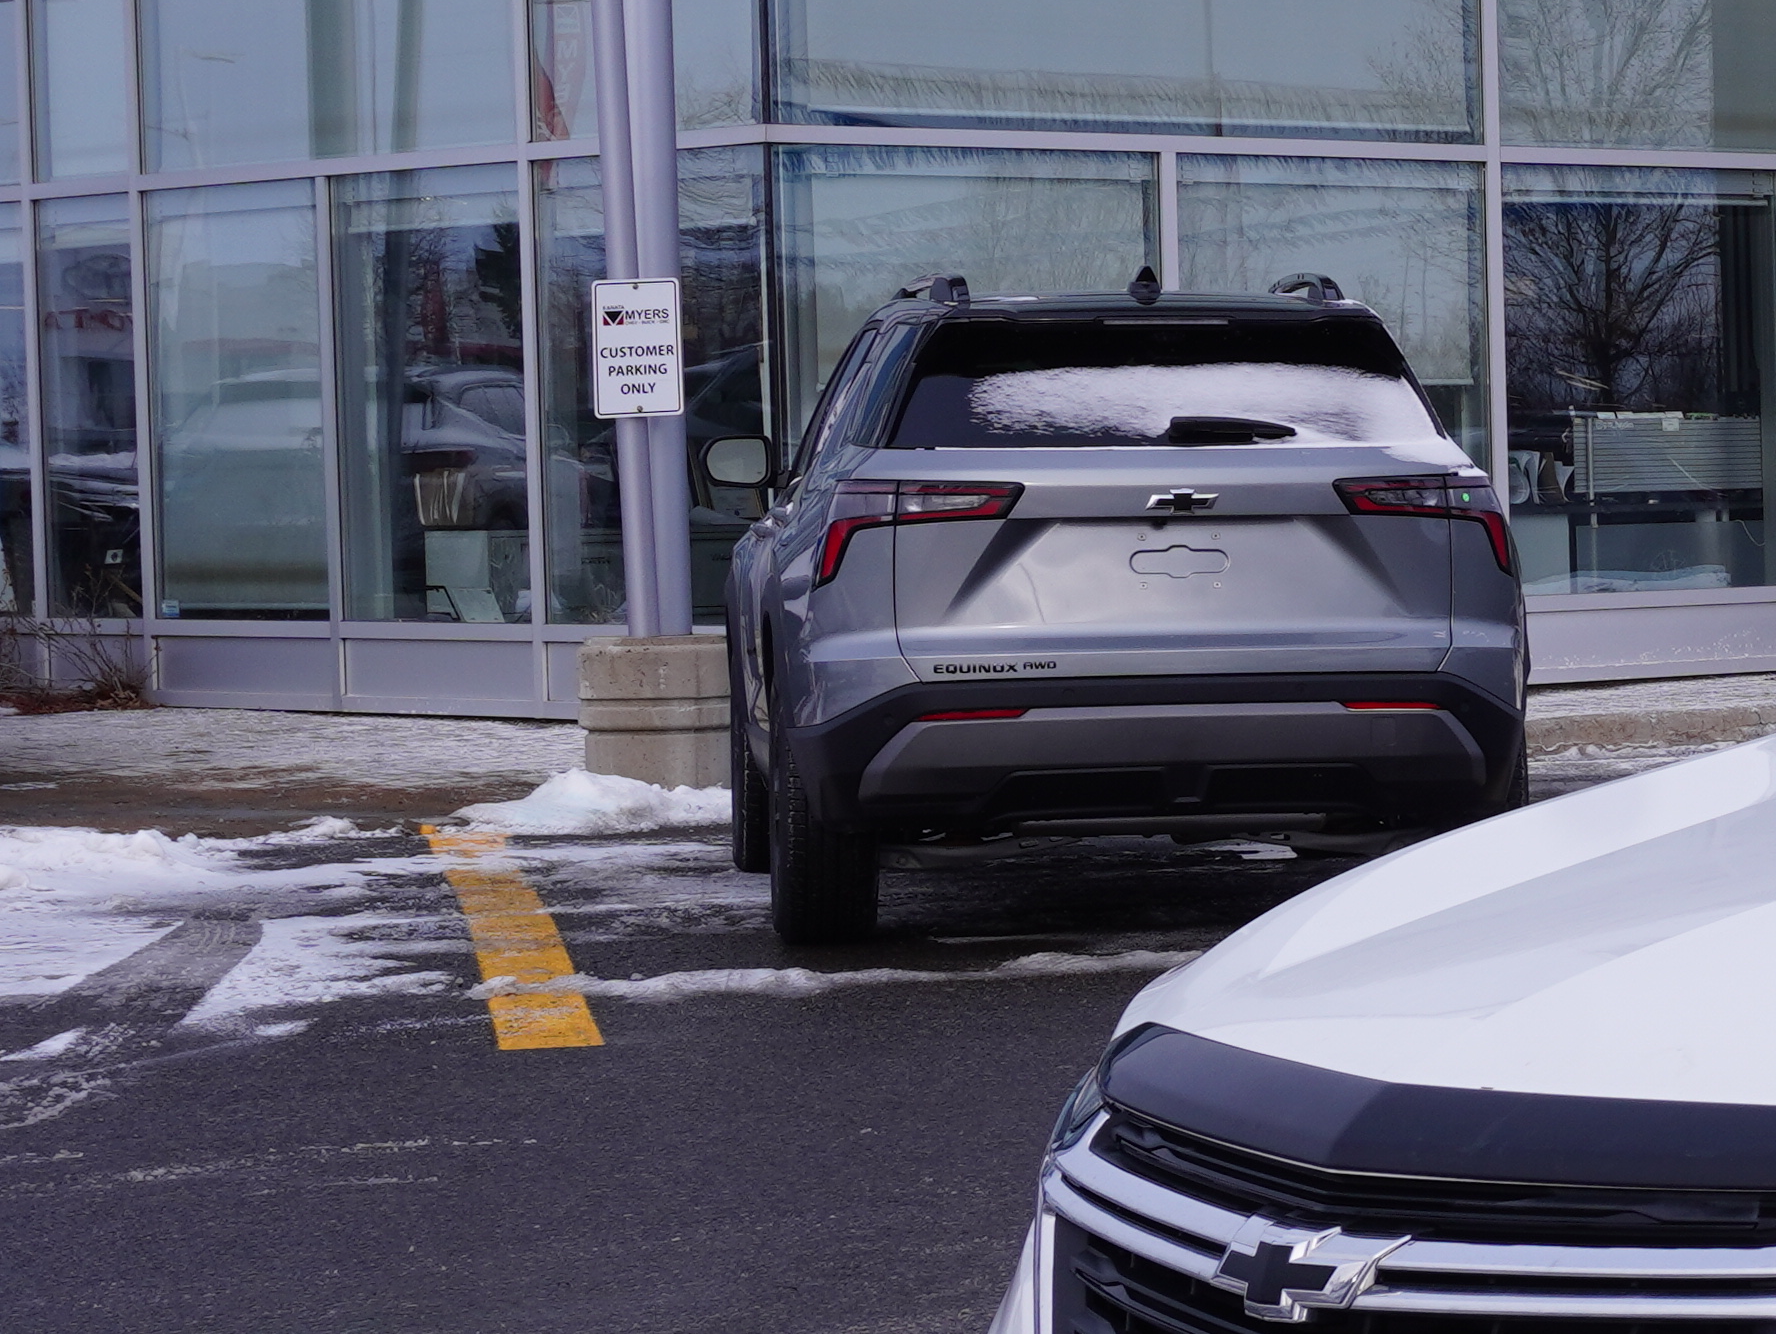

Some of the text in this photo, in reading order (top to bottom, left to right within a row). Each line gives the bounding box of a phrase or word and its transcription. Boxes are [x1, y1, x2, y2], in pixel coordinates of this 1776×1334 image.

[625, 308, 669, 320] MYERS
[600, 345, 674, 359] CUSTOMER
[608, 363, 668, 377] PARKING
[620, 382, 656, 395] ONLY
[933, 661, 1057, 675] EQUINOX AWD
